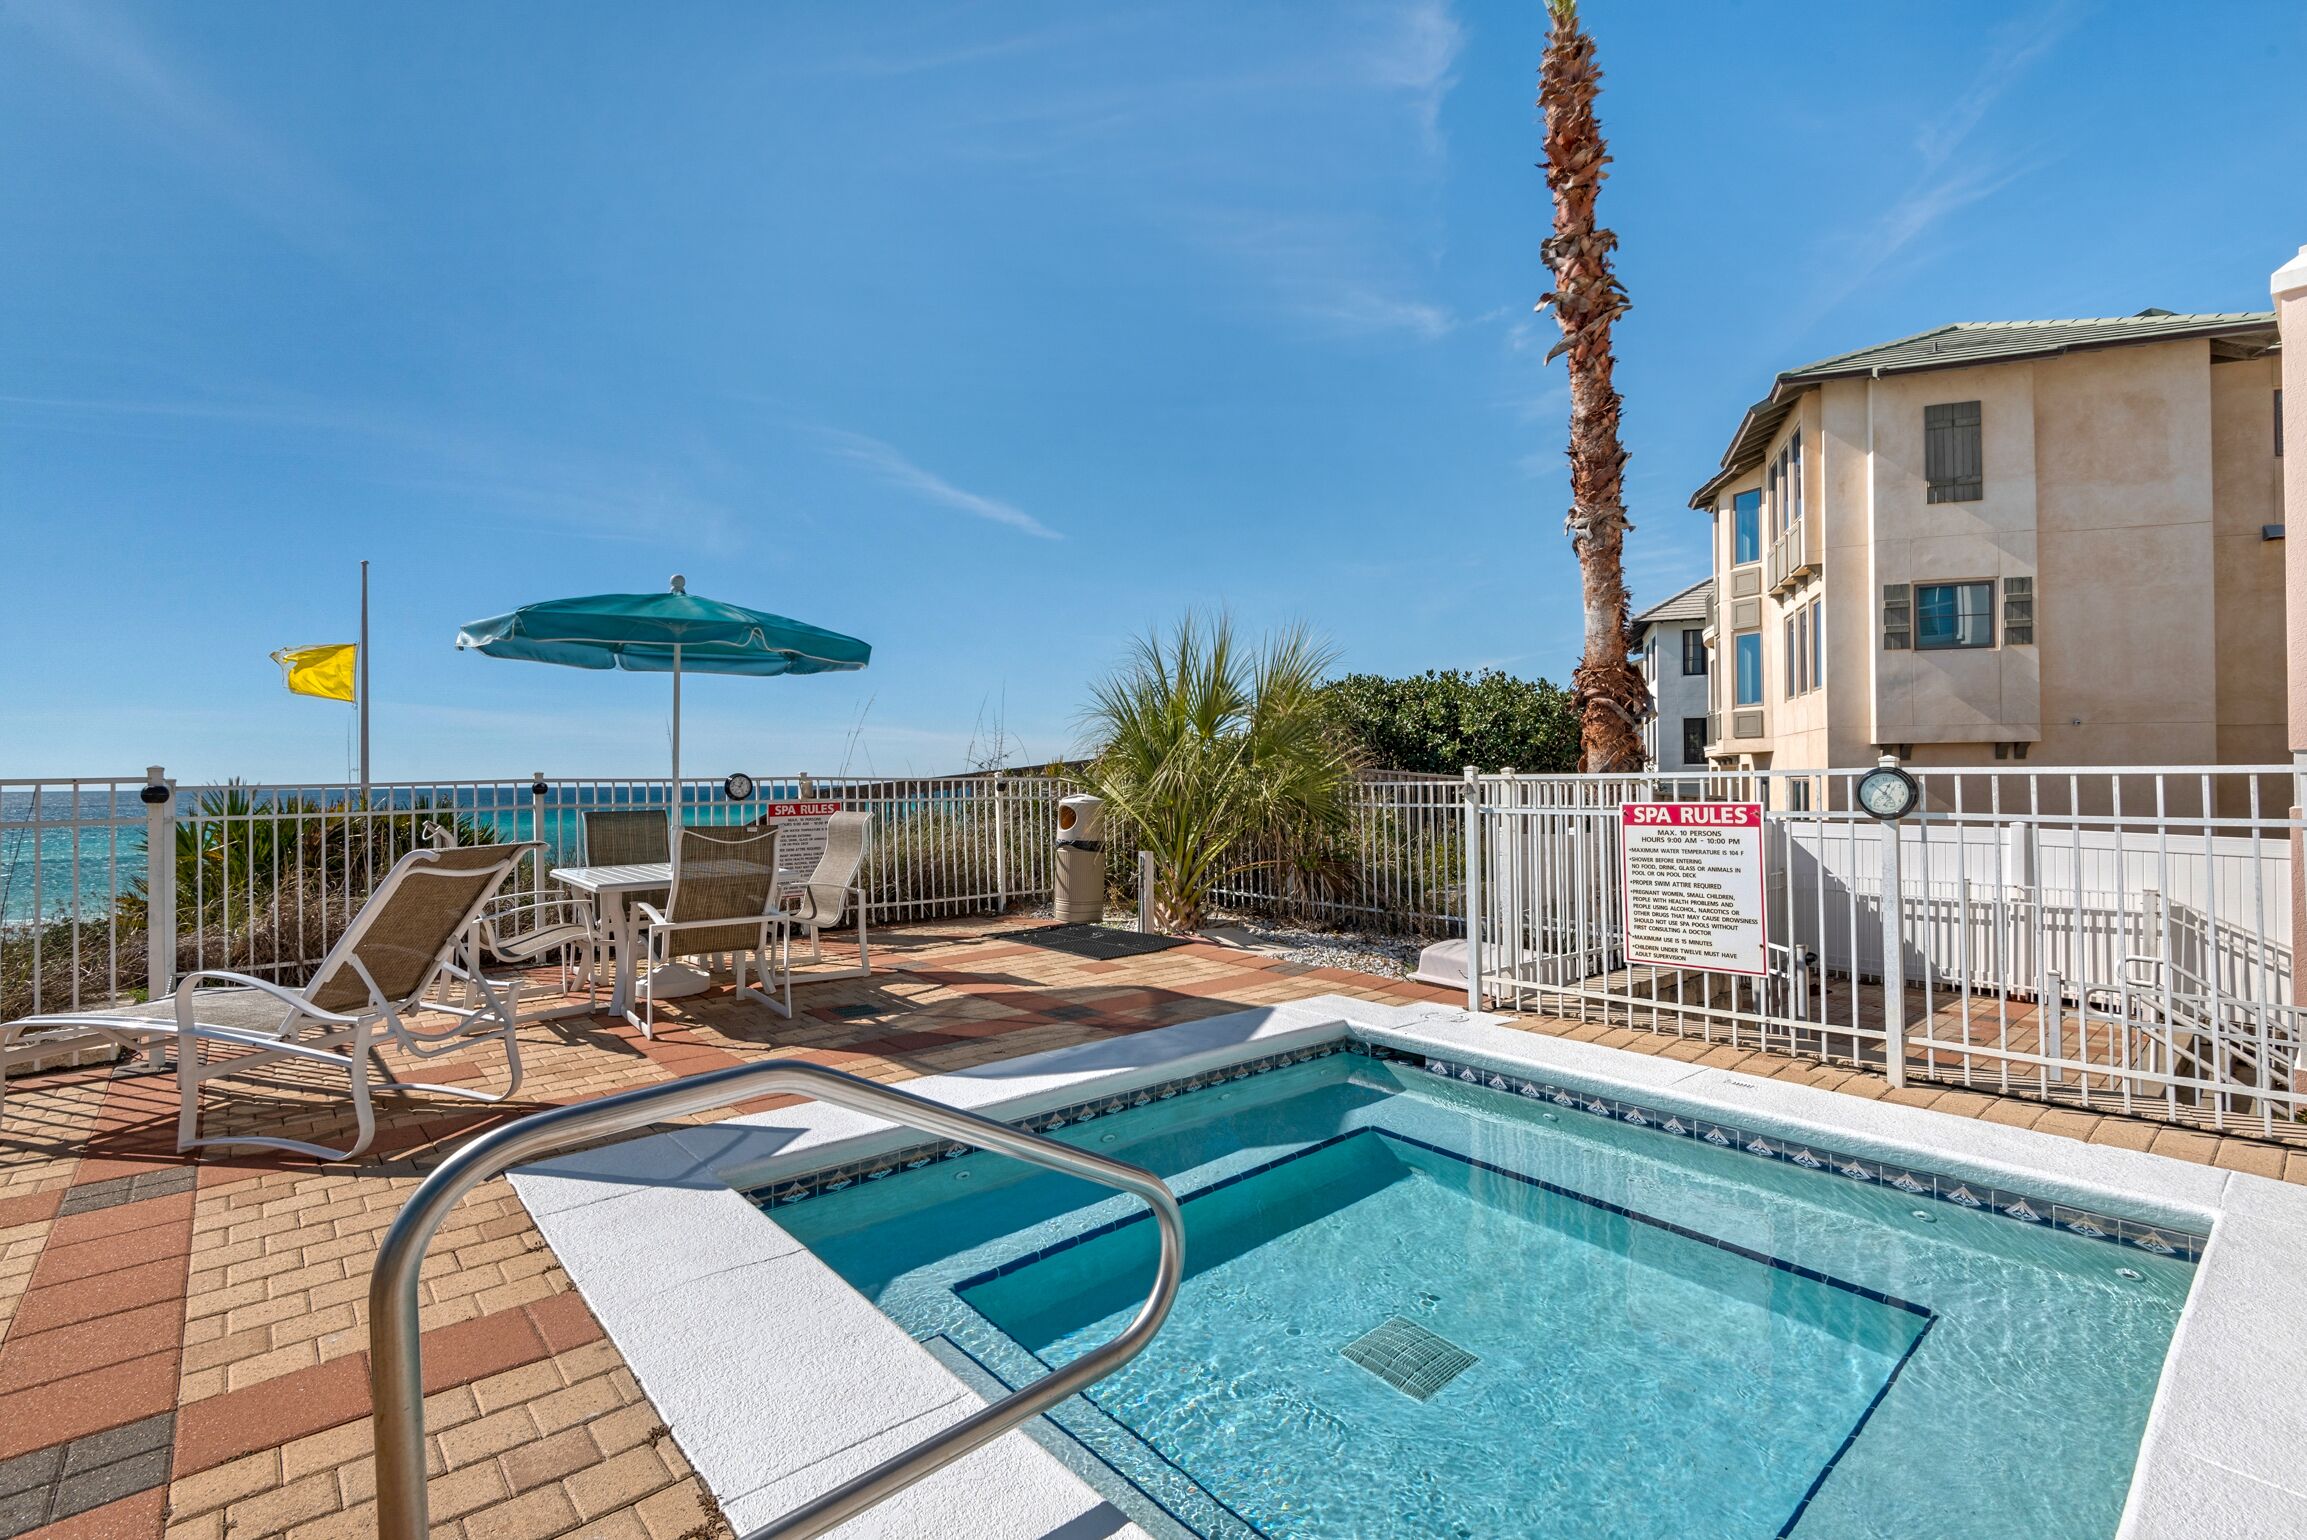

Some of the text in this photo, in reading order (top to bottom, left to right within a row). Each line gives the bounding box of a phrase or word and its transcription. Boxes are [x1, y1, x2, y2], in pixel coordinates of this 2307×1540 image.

[775, 804, 834, 816] SPA RULES
[1633, 807, 1748, 824] SPA RULES
[1682, 848, 1721, 856] TEMPERATURE
[1693, 882, 1722, 890] REQUIRED
[1661, 890, 1686, 898] WOMEN,
[1706, 893, 1736, 901] CHILDREN,
[1670, 905, 1697, 913] ALCOHOL,
[1698, 907, 1730, 915] NARCOTICS
[1671, 912, 1685, 920] THAT
[1721, 916, 1759, 925] DROWSINESS
[1648, 925, 1681, 934] CONSULTING
[1688, 928, 1712, 936] DOCTOR
[1691, 921, 1710, 929] POOLS
[1711, 923, 1739, 931] WITHOUT
[1688, 939, 1713, 947] MINUTES
[1634, 943, 1660, 951] CHILDREN
[1660, 945, 1679, 953] UNDER
[1680, 948, 1702, 956] TWELVE
[1653, 952, 1687, 961] SUPERVISION
